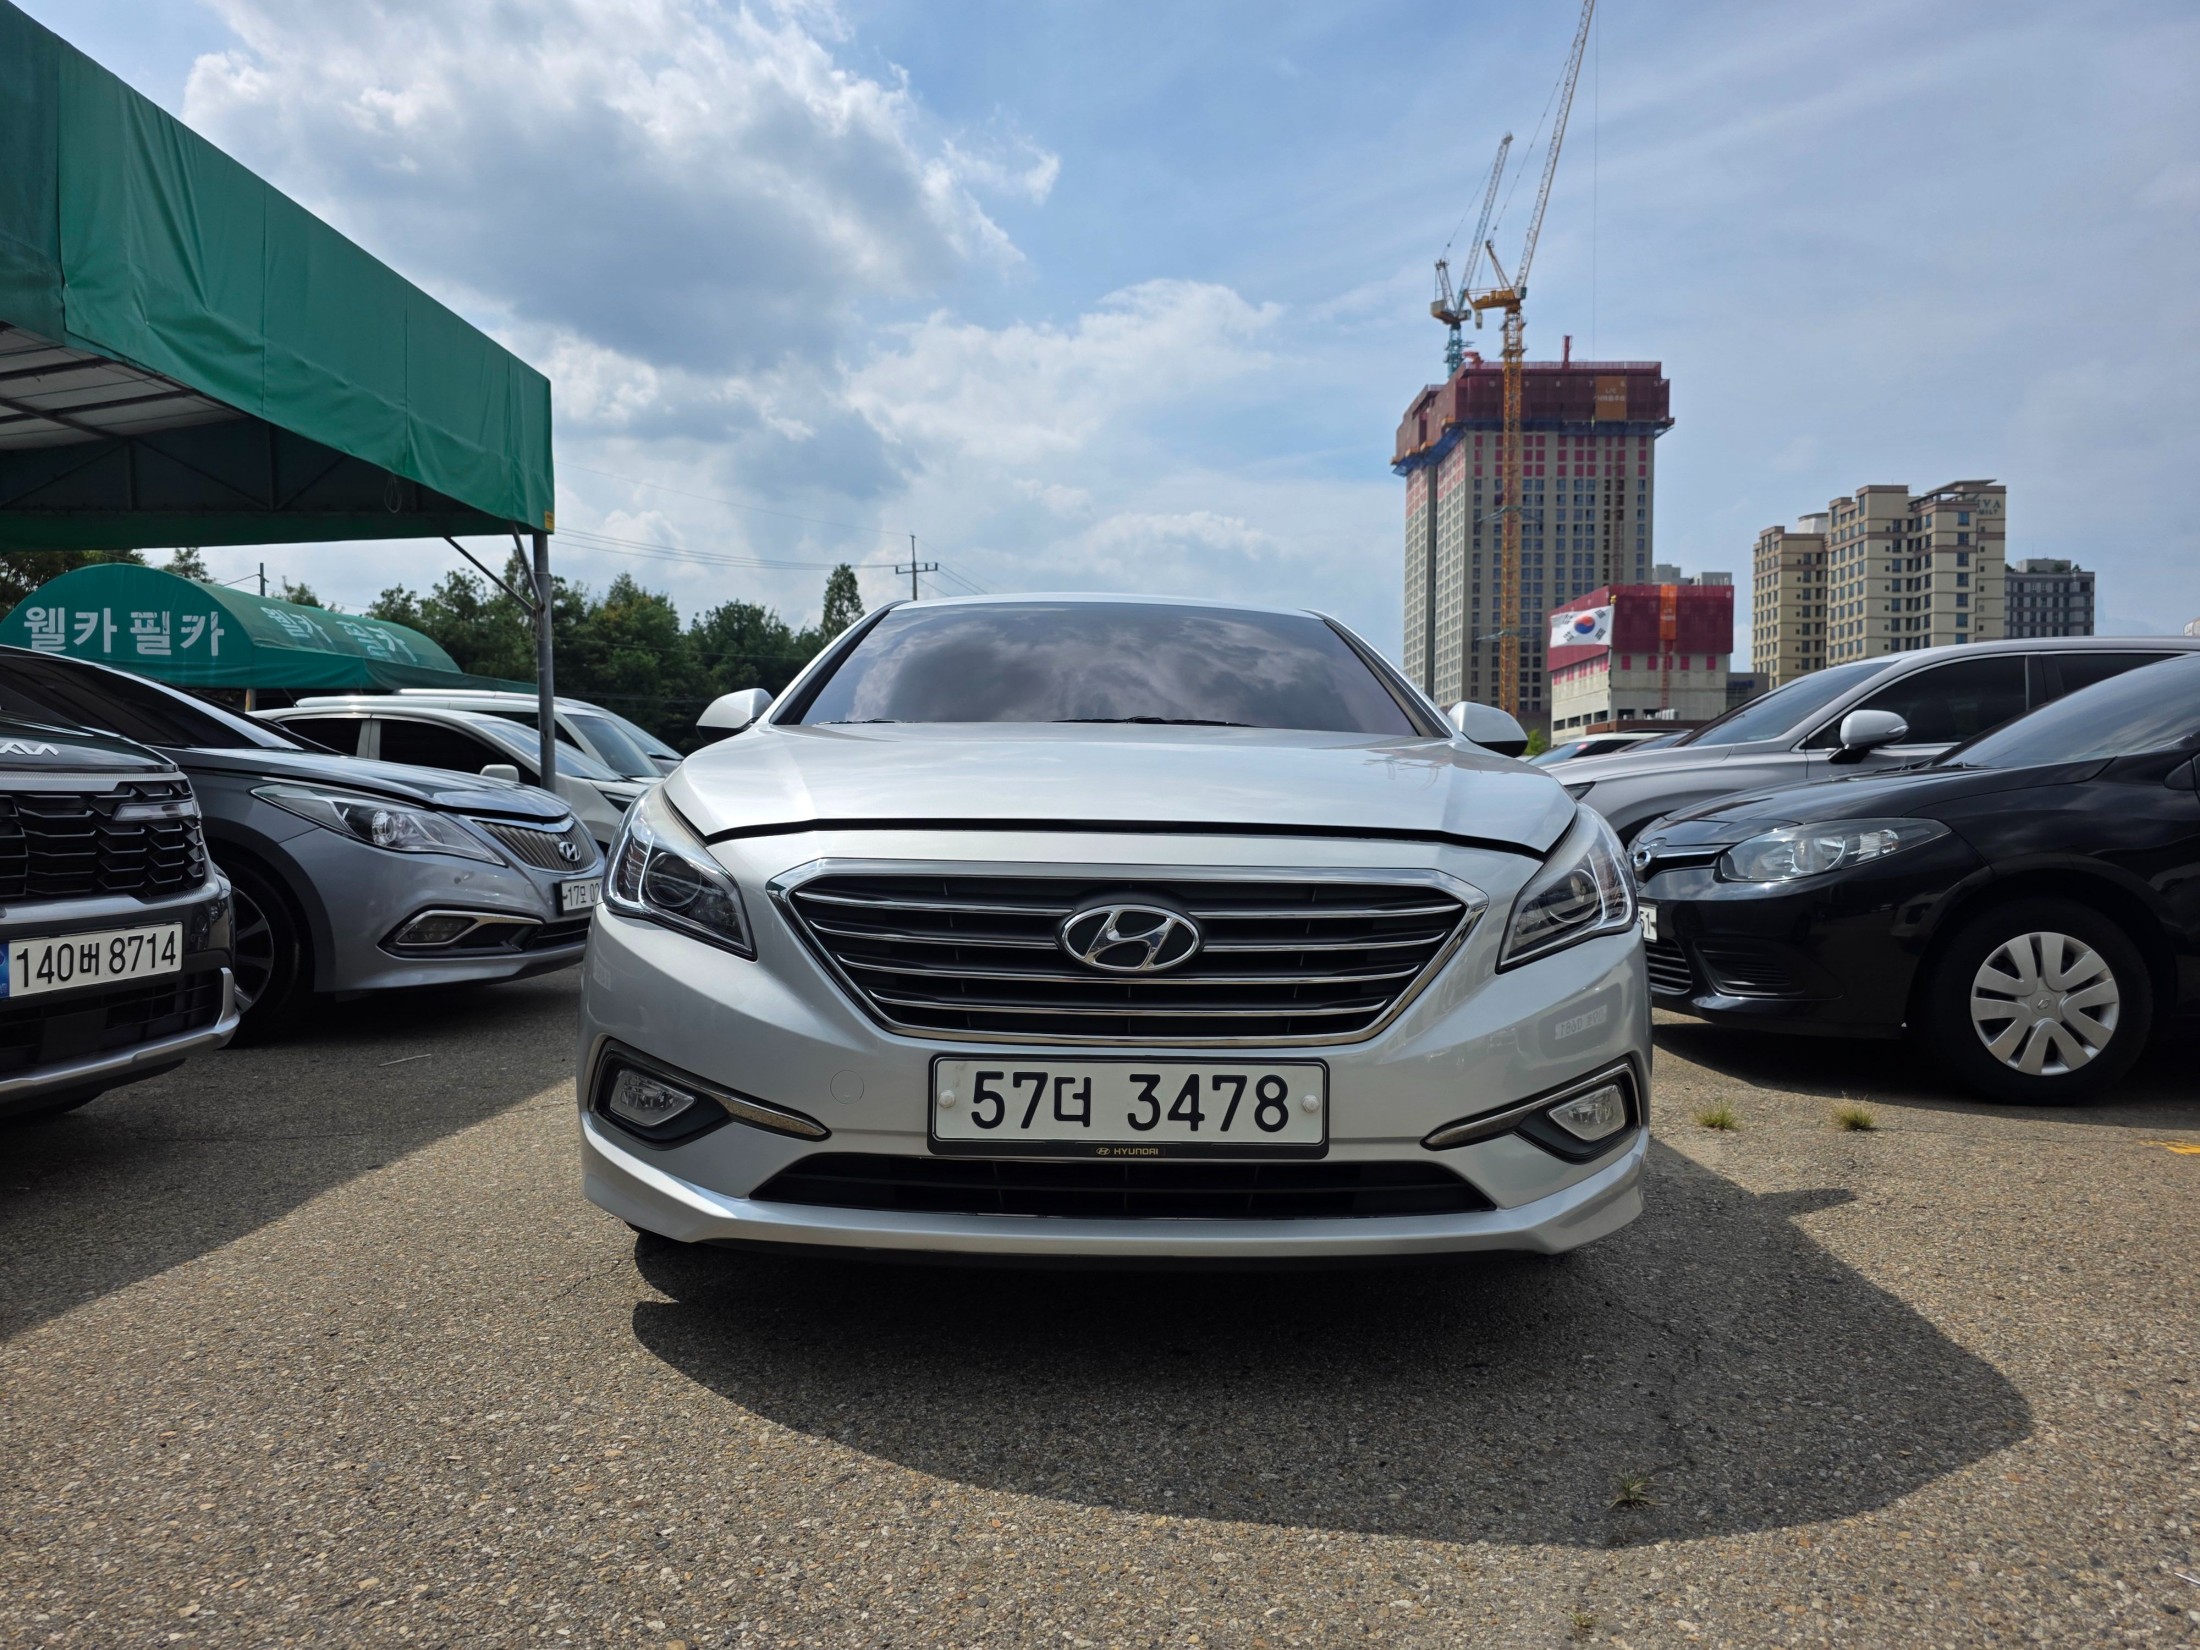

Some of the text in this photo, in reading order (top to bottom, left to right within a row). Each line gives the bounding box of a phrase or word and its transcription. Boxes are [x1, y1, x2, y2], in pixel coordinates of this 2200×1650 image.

[24, 606, 225, 656] 웰카 필카
[16, 931, 176, 988] 140버 8714
[971, 1071, 1289, 1132] 57더 3478
[1113, 1147, 1159, 1155] HYUNDAI
